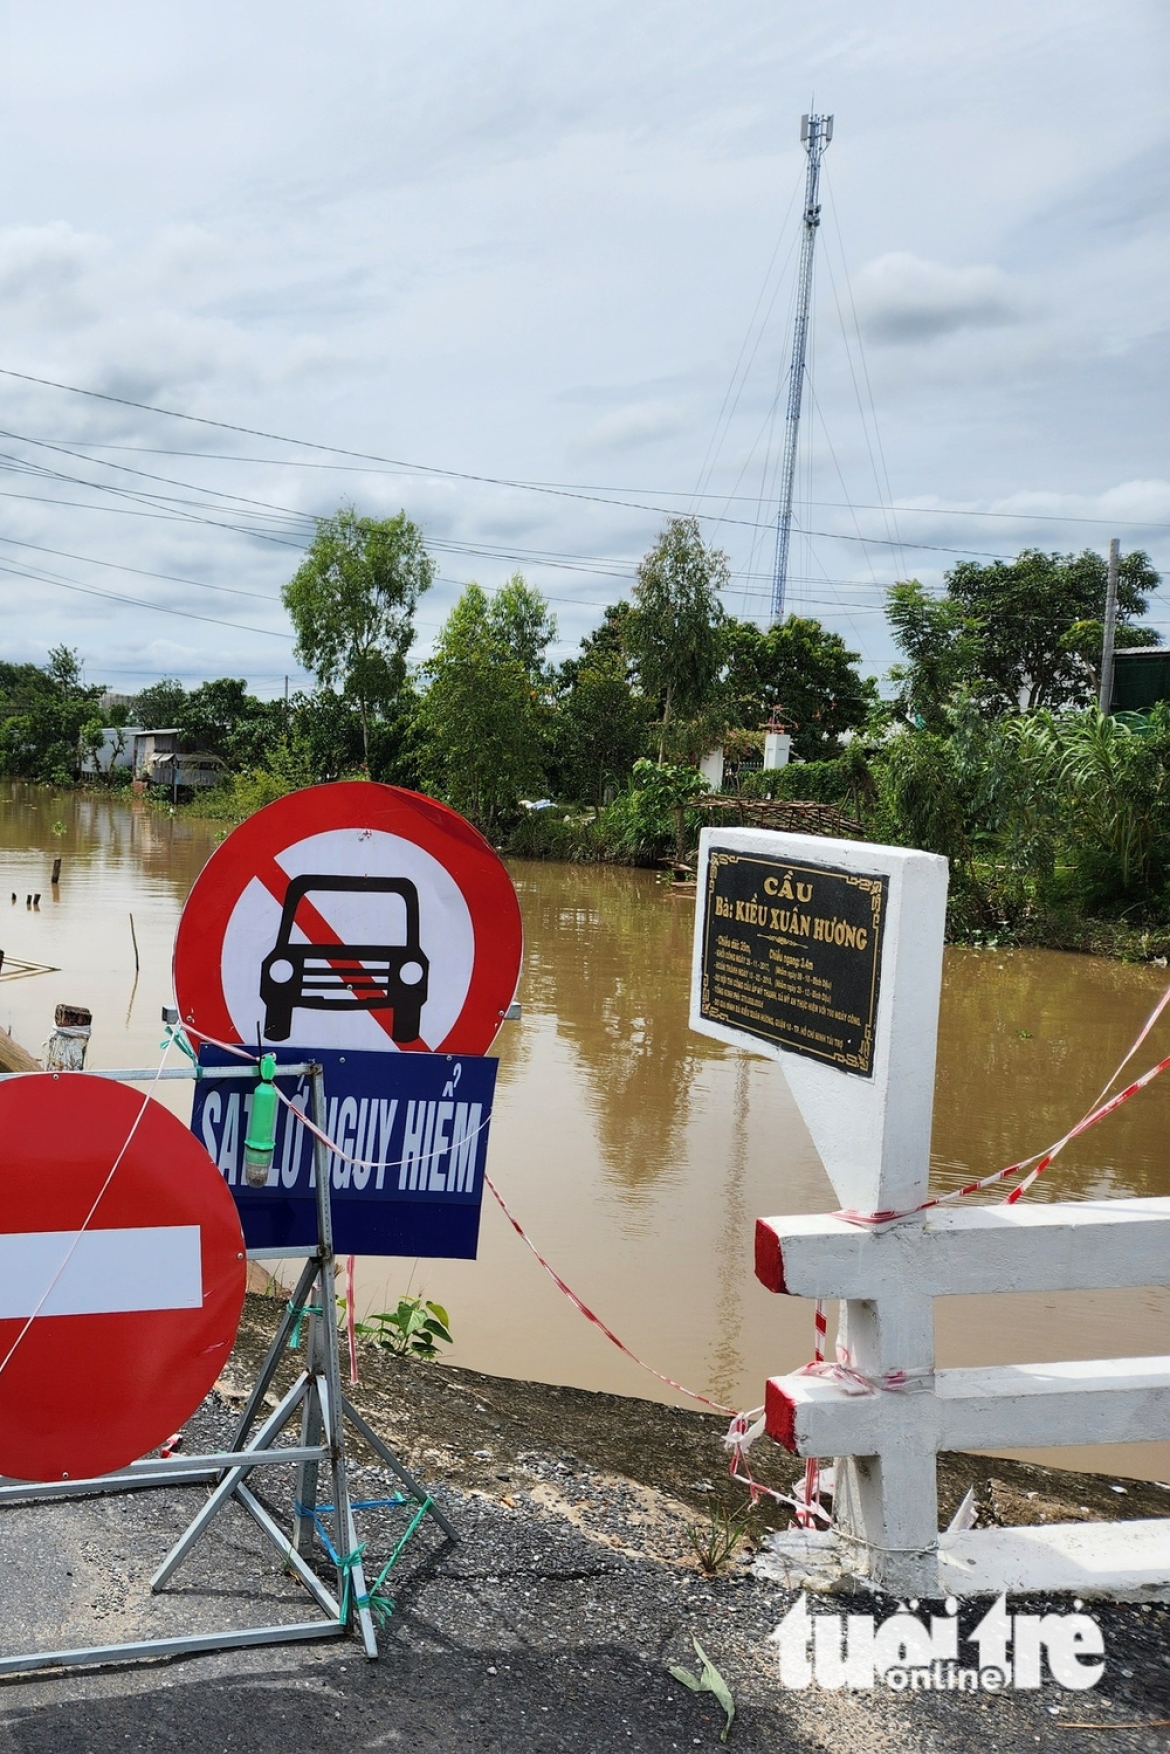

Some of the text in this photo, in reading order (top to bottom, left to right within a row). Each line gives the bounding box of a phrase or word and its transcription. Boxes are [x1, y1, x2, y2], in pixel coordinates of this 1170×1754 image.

[763, 870, 813, 902] CẦU
[715, 896, 733, 918] Bà:
[735, 893, 768, 926] KIỀU
[813, 916, 868, 950] HƯƠNG
[309, 1096, 398, 1190] NGUY
[398, 1063, 483, 1193] HIỂM
